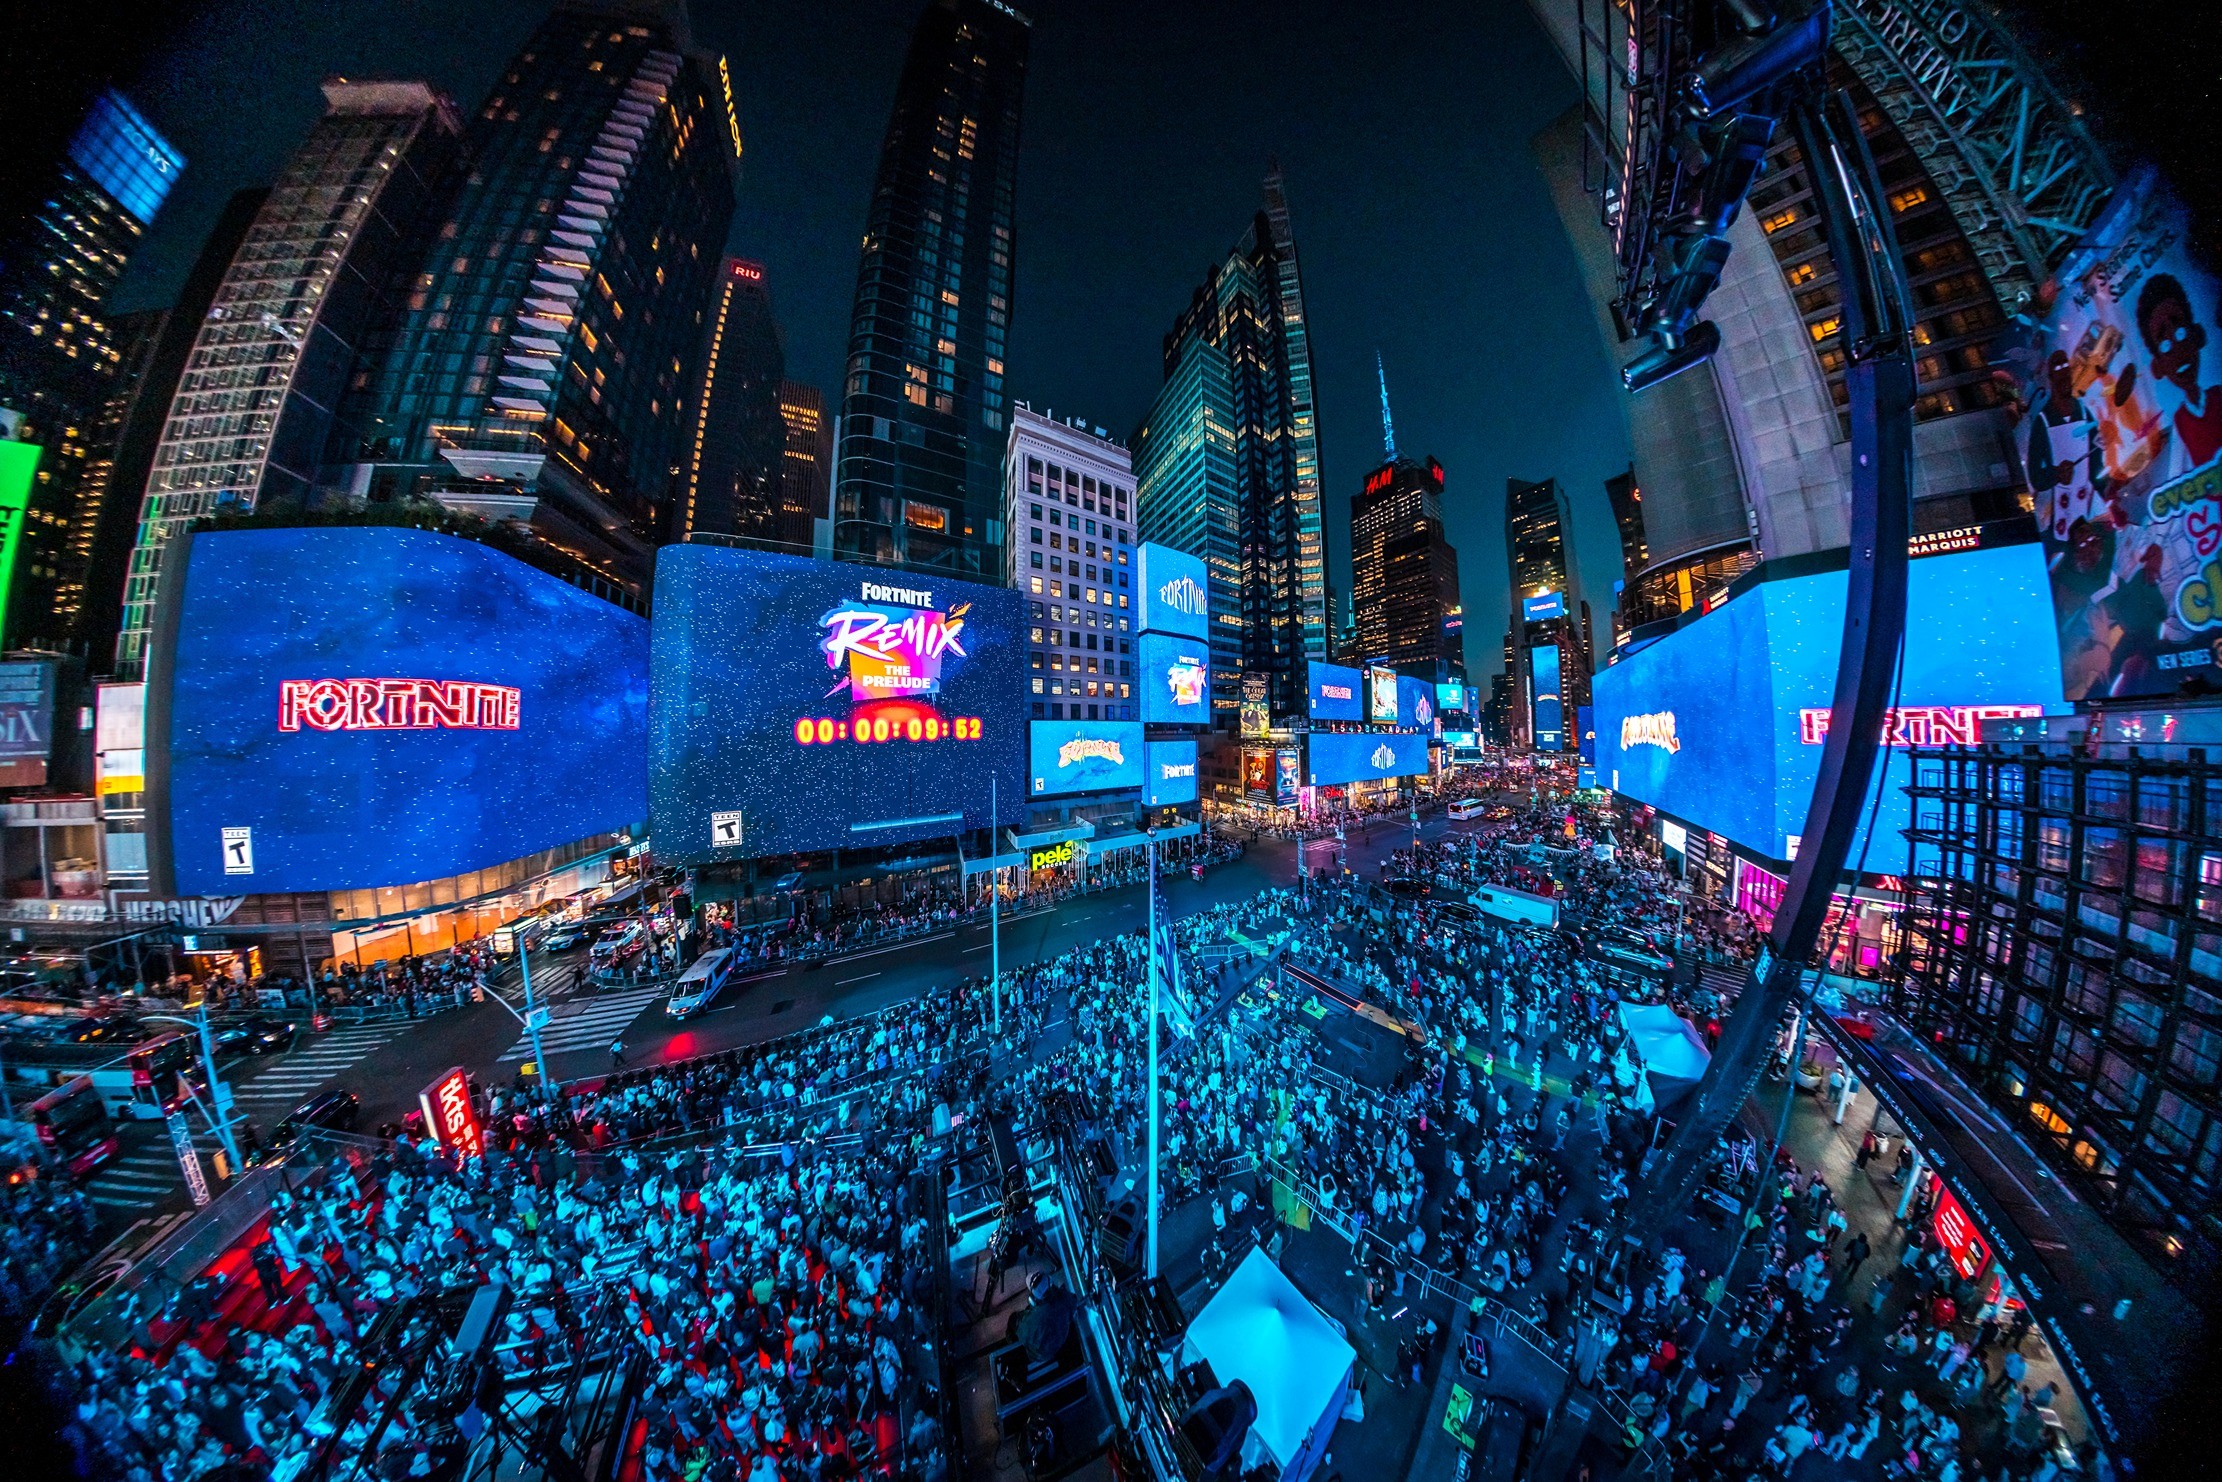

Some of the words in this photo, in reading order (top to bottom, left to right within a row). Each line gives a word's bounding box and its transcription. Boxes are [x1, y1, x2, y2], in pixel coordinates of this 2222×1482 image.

[735, 266, 761, 280] RIU
[1908, 536, 1977, 556] MARQUIS
[861, 581, 933, 608] FORTNITE
[884, 665, 911, 676] THE
[862, 675, 931, 689] PRELUDE
[278, 679, 521, 732] FORTNITE
[717, 820, 736, 839] T
[228, 841, 245, 864] T
[439, 1076, 465, 1135] tkts
[1951, 1175, 1990, 1225] AMERICAN
[1989, 1225, 2016, 1262] EAGLE
